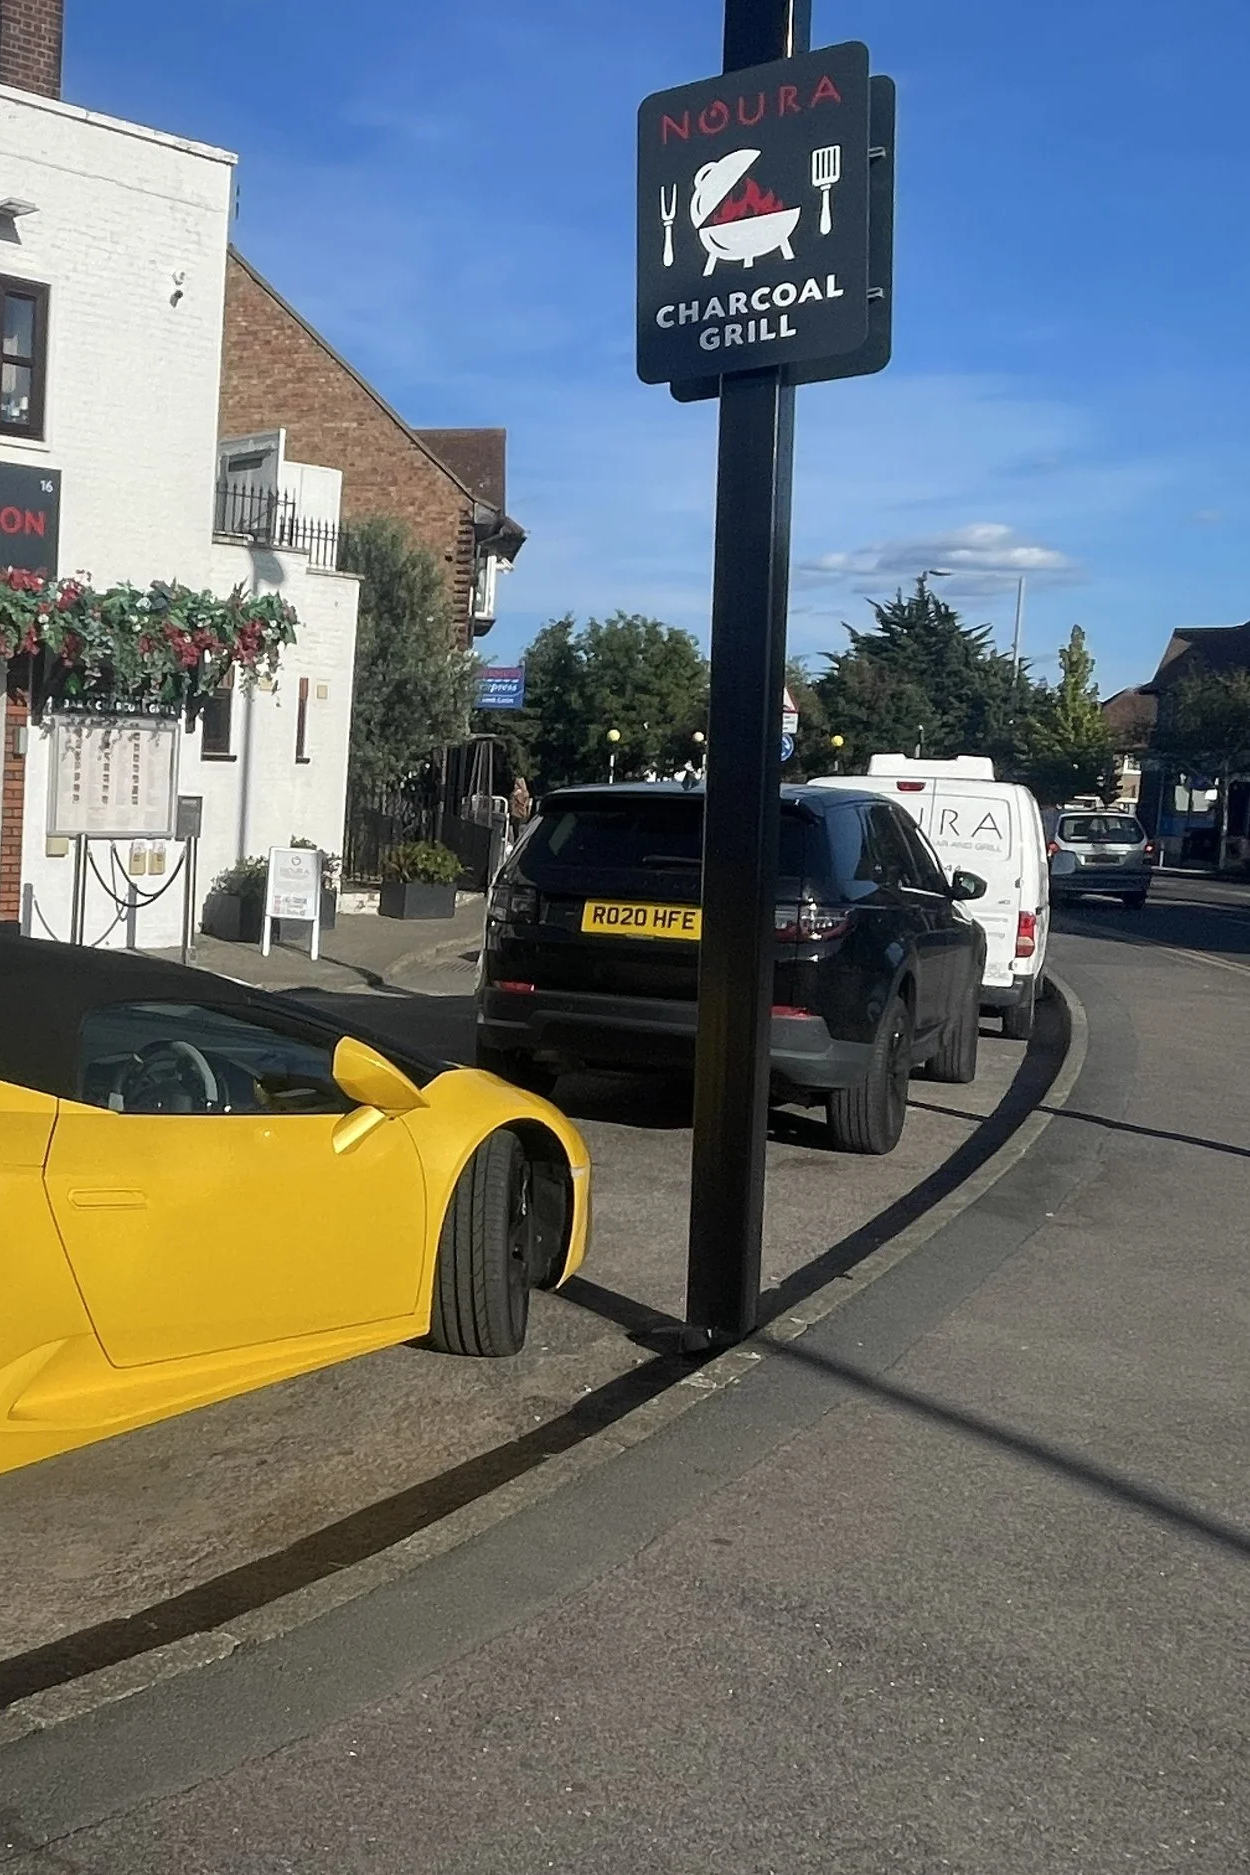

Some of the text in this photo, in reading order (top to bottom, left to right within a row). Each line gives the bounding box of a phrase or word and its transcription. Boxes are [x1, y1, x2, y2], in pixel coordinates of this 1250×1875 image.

[659, 74, 842, 145] NOURA
[655, 274, 844, 329] CHARCOAL
[699, 314, 797, 350] GRILL
[40, 480, 54, 493] 16
[592, 906, 697, 930] RO20 HFE
